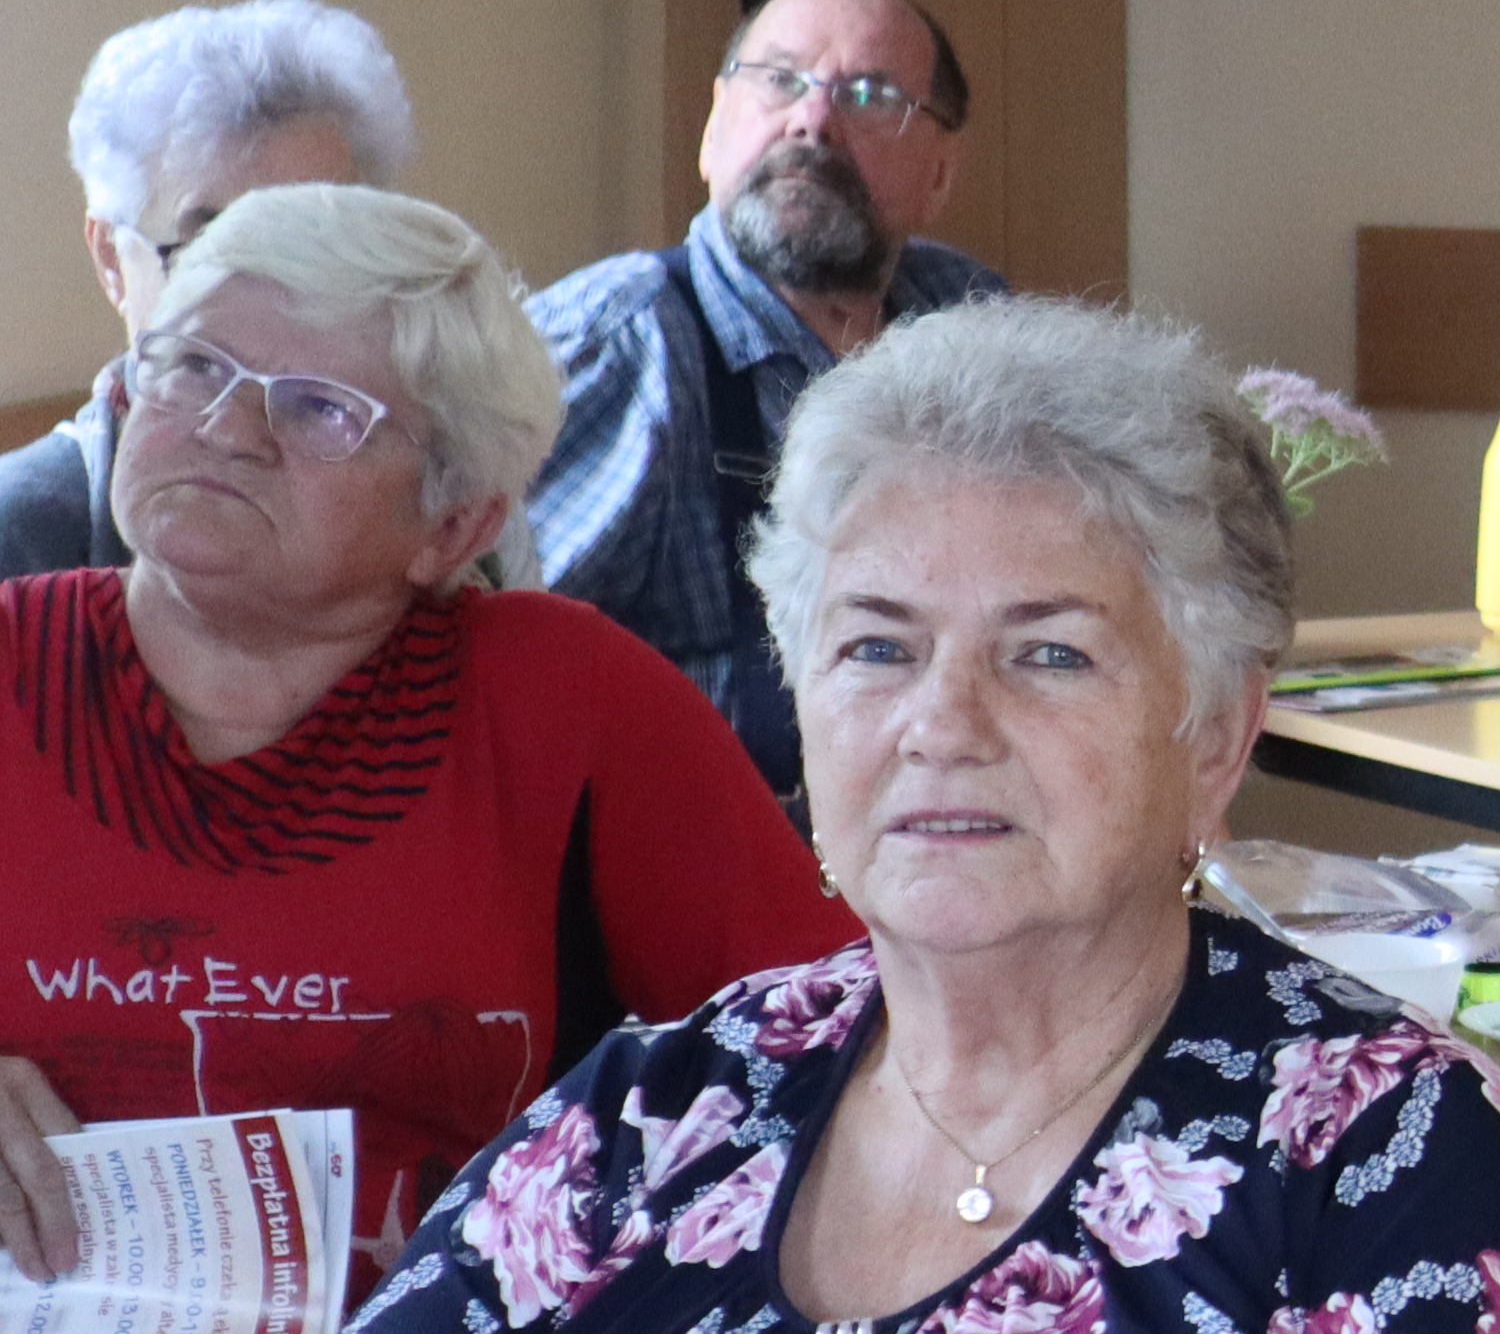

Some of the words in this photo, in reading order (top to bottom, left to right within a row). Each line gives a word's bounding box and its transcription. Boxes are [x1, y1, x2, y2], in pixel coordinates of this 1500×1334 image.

[83, 1153, 117, 1235] specjalista
[107, 1149, 139, 1216] WTOREK
[142, 1146, 175, 1229] specjalista
[166, 1143, 207, 1258] PONIEDZIAŁEK
[196, 1138, 217, 1174] Przy
[207, 1179, 236, 1250] telefonie
[246, 1132, 290, 1257] Bezpłatna
